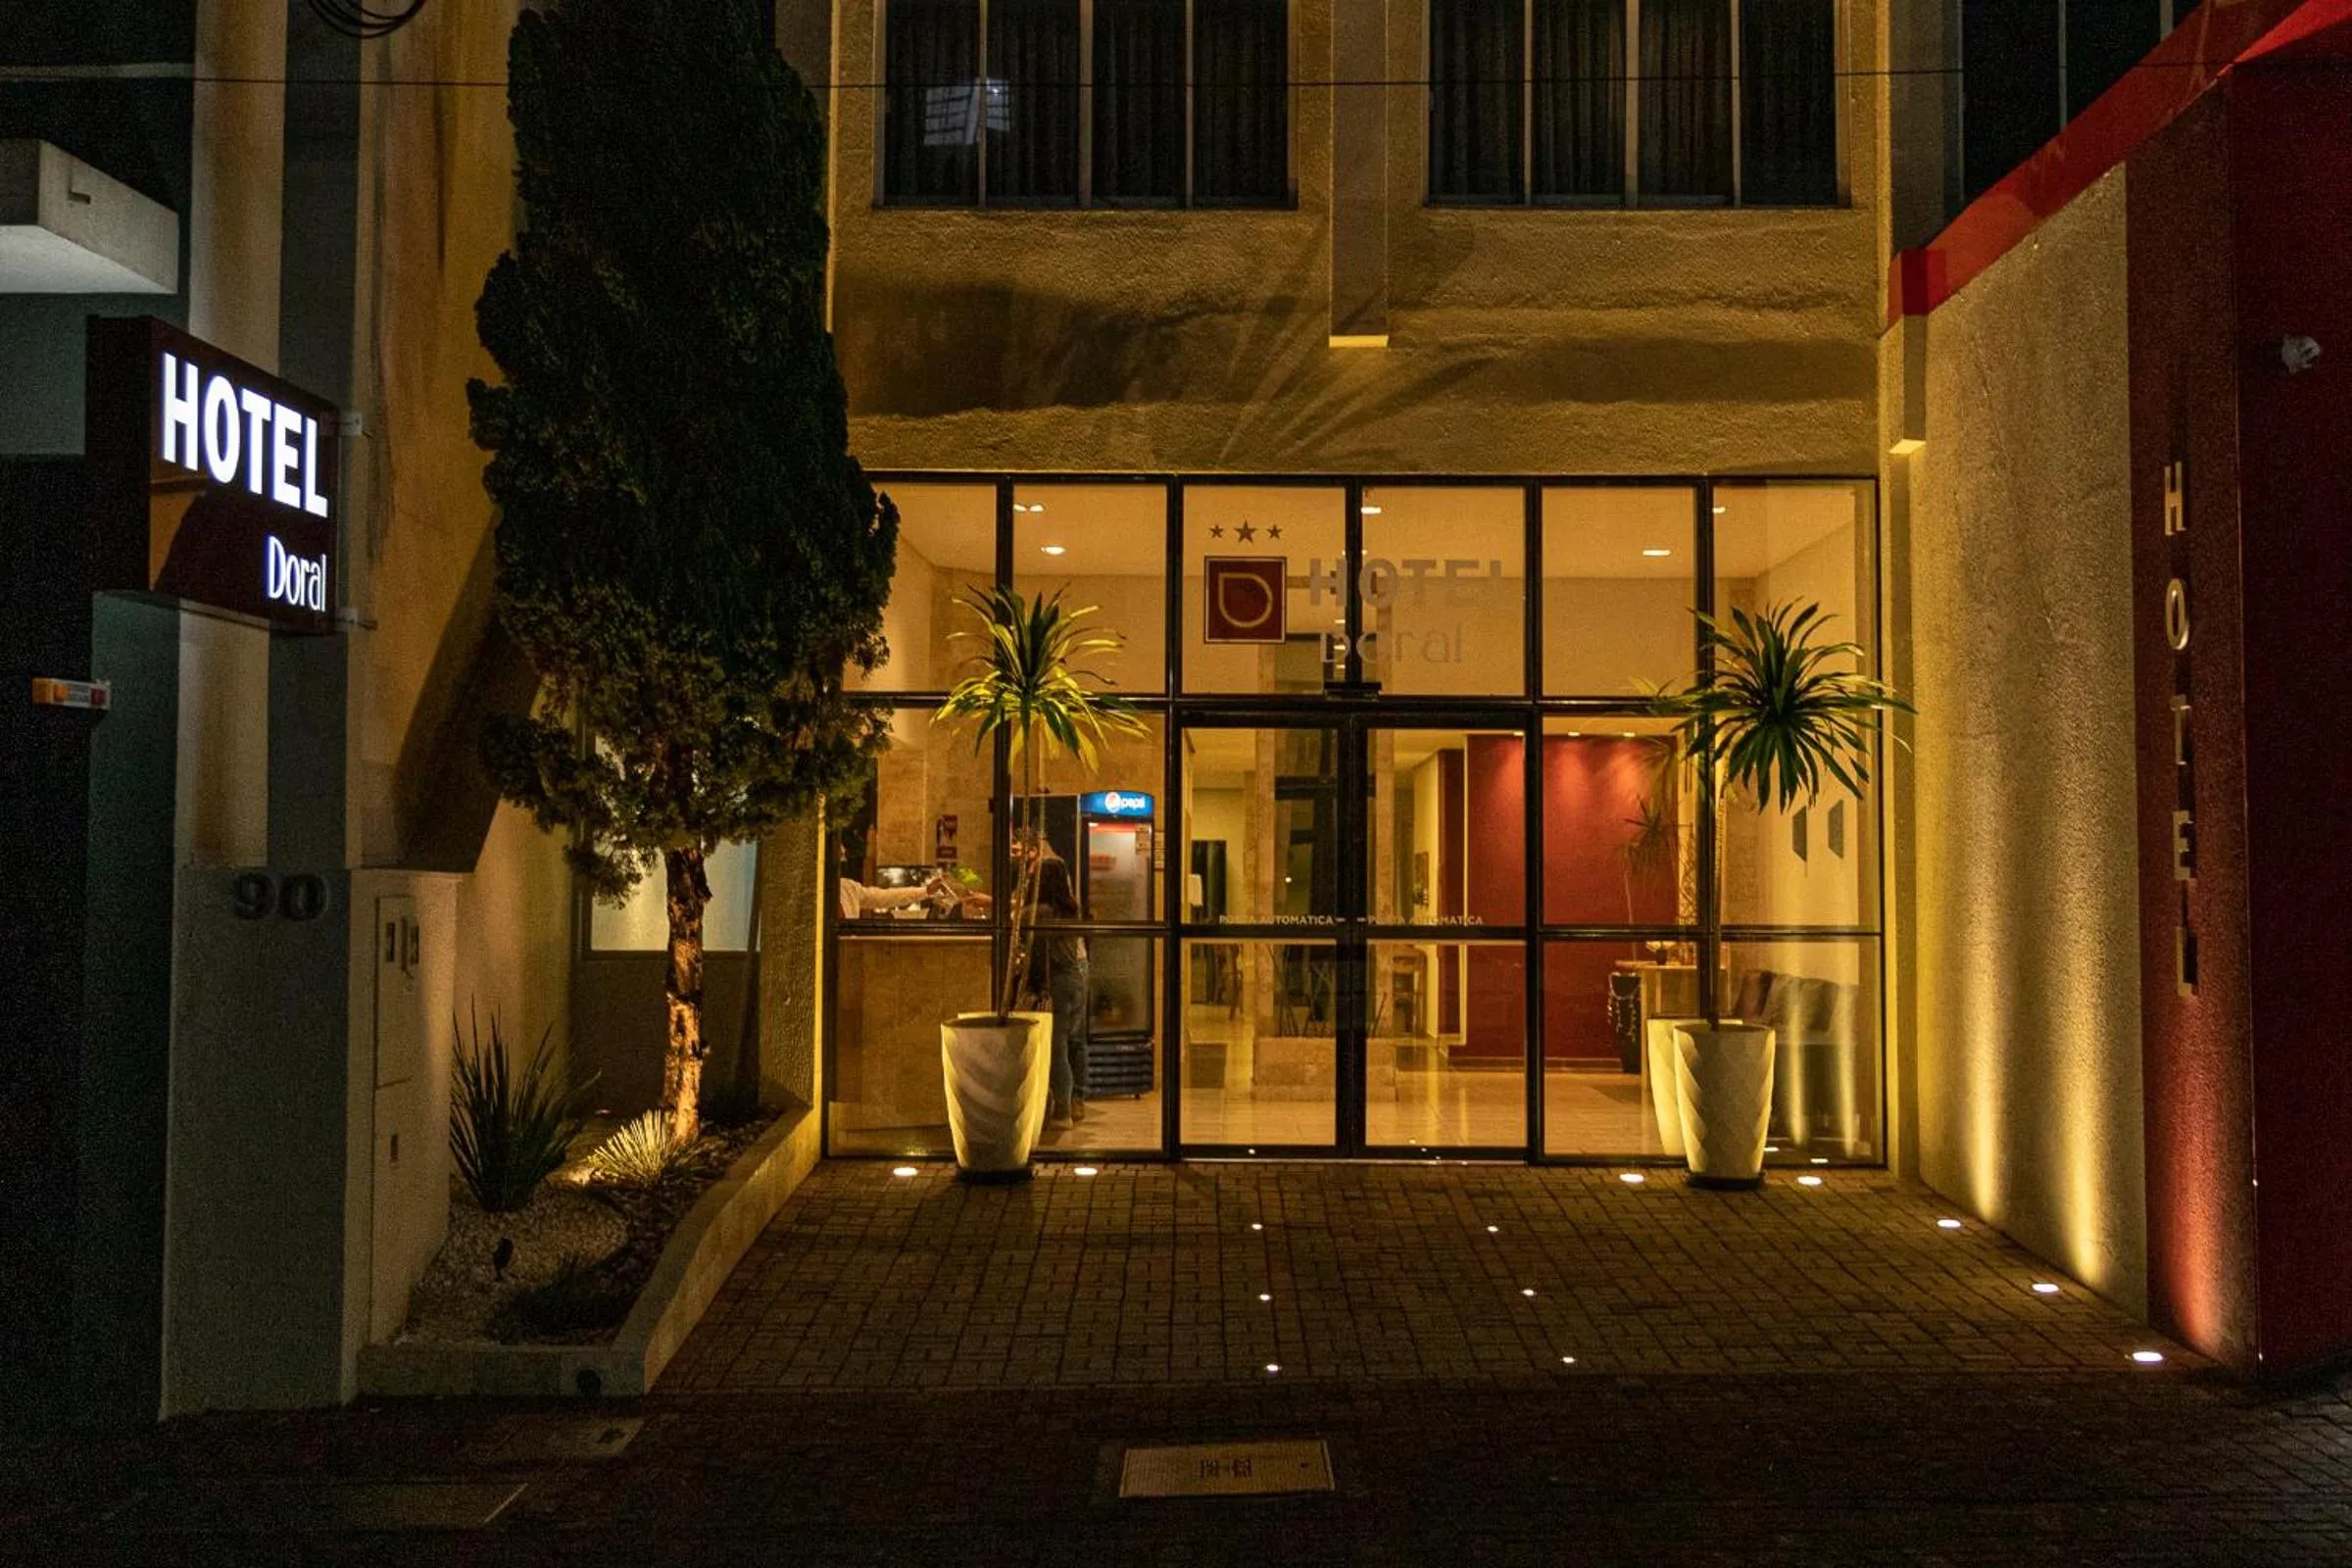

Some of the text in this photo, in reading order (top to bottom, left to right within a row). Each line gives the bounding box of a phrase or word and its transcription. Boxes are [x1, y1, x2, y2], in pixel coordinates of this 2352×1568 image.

[162, 352, 328, 517] HOTEL
[267, 534, 327, 612] Doral
[1319, 622, 1463, 663] Doral
[2163, 461, 2195, 997] HOTEL
[233, 872, 325, 920] 90
[1219, 914, 1255, 925] POA
[1368, 914, 1484, 925] PTA AOMATCA
